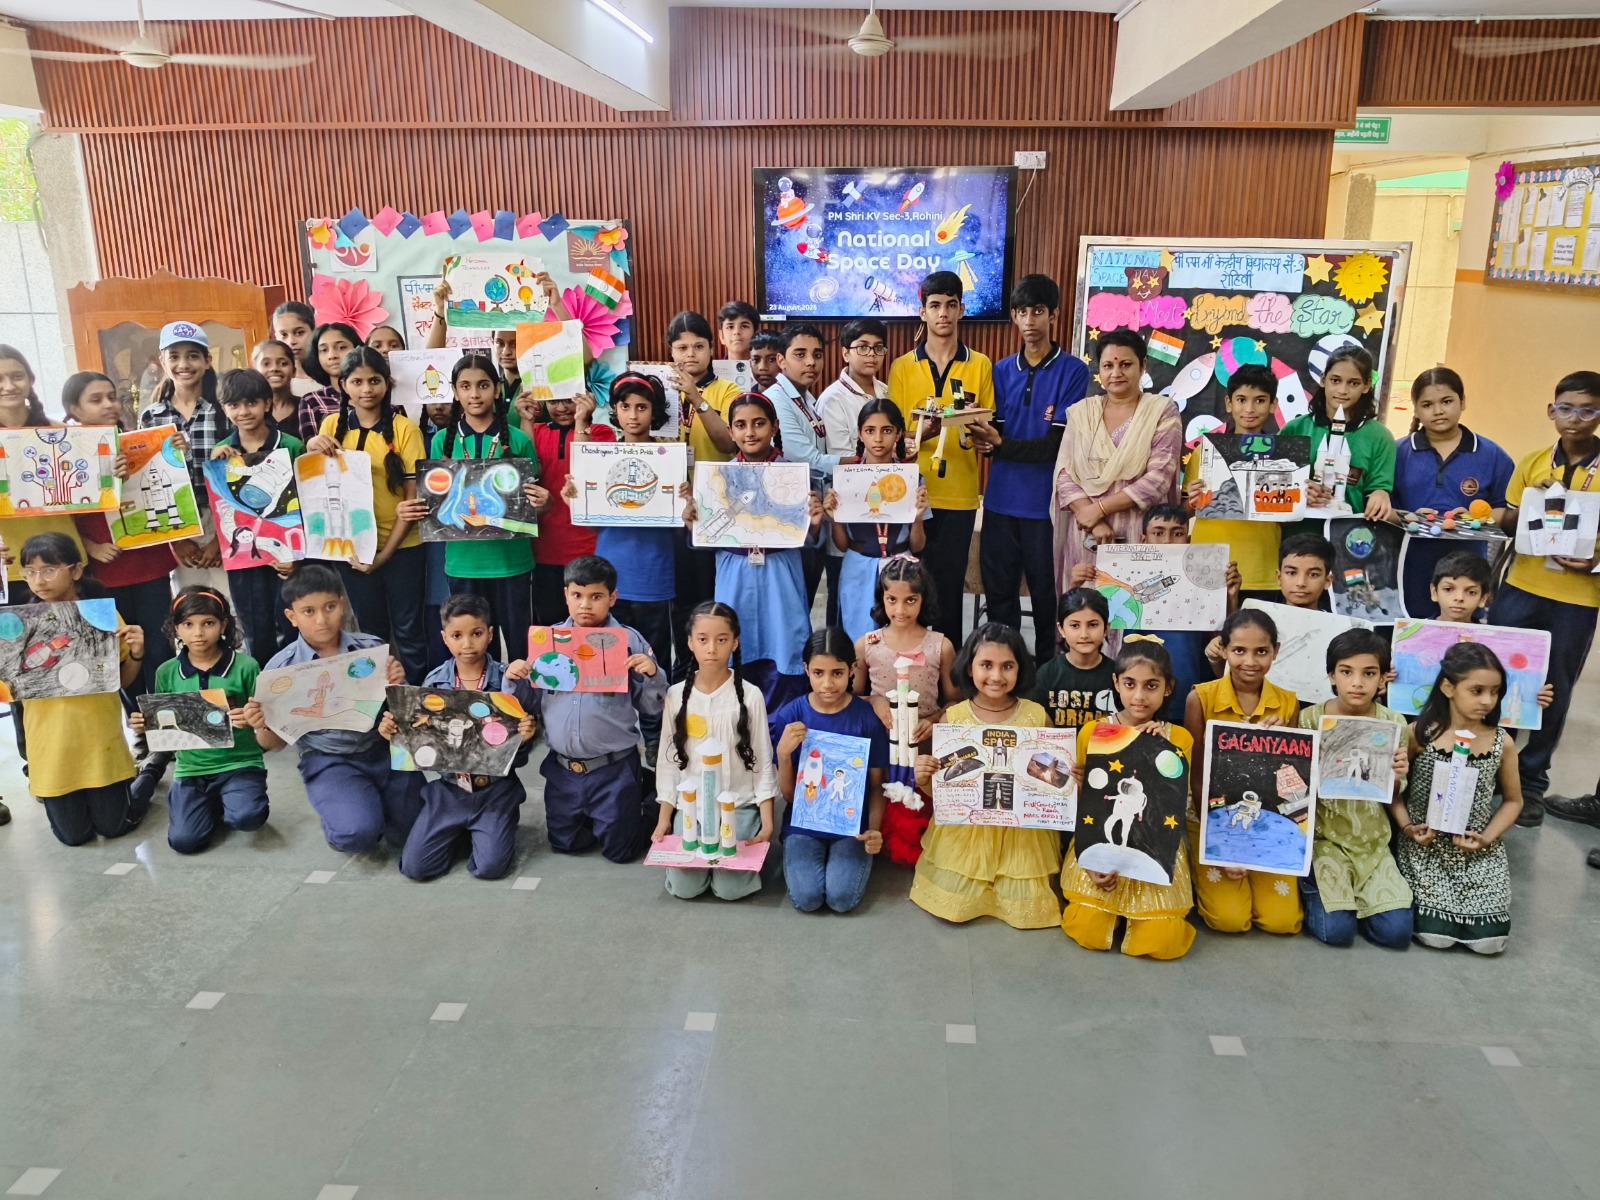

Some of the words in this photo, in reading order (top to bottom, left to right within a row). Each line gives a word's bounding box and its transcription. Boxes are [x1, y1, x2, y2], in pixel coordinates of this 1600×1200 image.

[828, 212, 843, 220] PM
[845, 211, 864, 220] Shri
[866, 212, 881, 220] KV
[837, 230, 930, 248] National
[826, 254, 891, 272] Space
[897, 254, 941, 272] Day
[1092, 252, 1156, 267] NATIONAL
[1090, 268, 1126, 284] SPACE
[1134, 270, 1158, 279] DAY
[1048, 690, 1094, 708] LOST
[1218, 732, 1312, 758] GAGANYAAN
